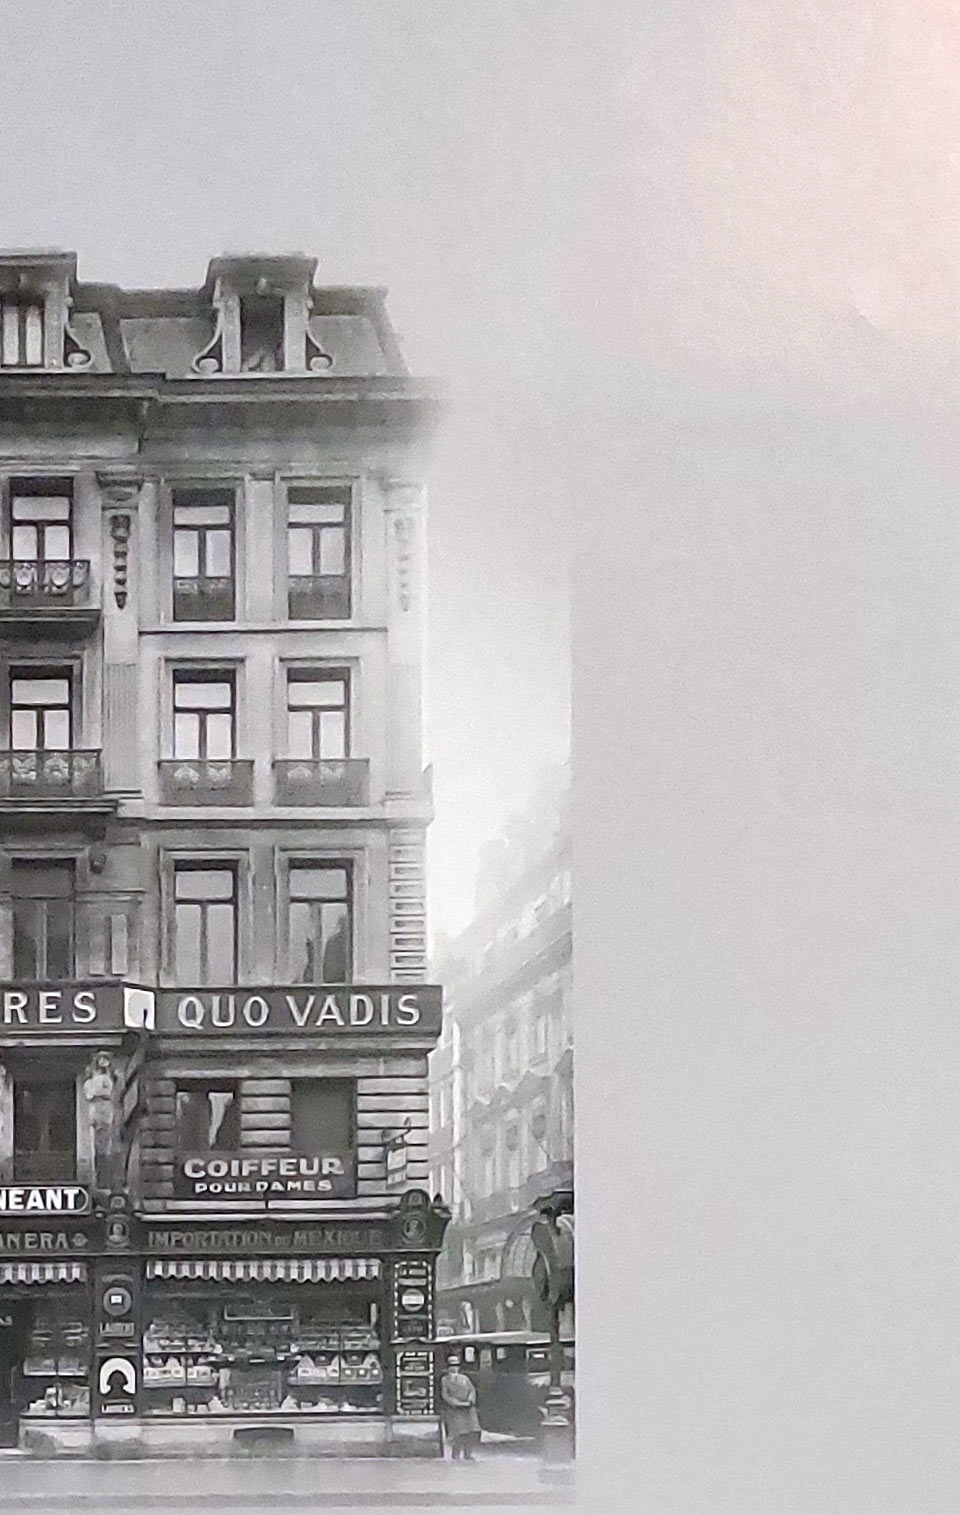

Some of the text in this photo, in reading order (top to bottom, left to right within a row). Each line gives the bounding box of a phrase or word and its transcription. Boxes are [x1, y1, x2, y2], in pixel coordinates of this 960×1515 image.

[177, 993, 421, 1029] QUO VADIS
[183, 1157, 345, 1179] COIFFEUR
[194, 1179, 333, 1194] POUR DAMES
[147, 1230, 273, 1248] IMPORTATION
